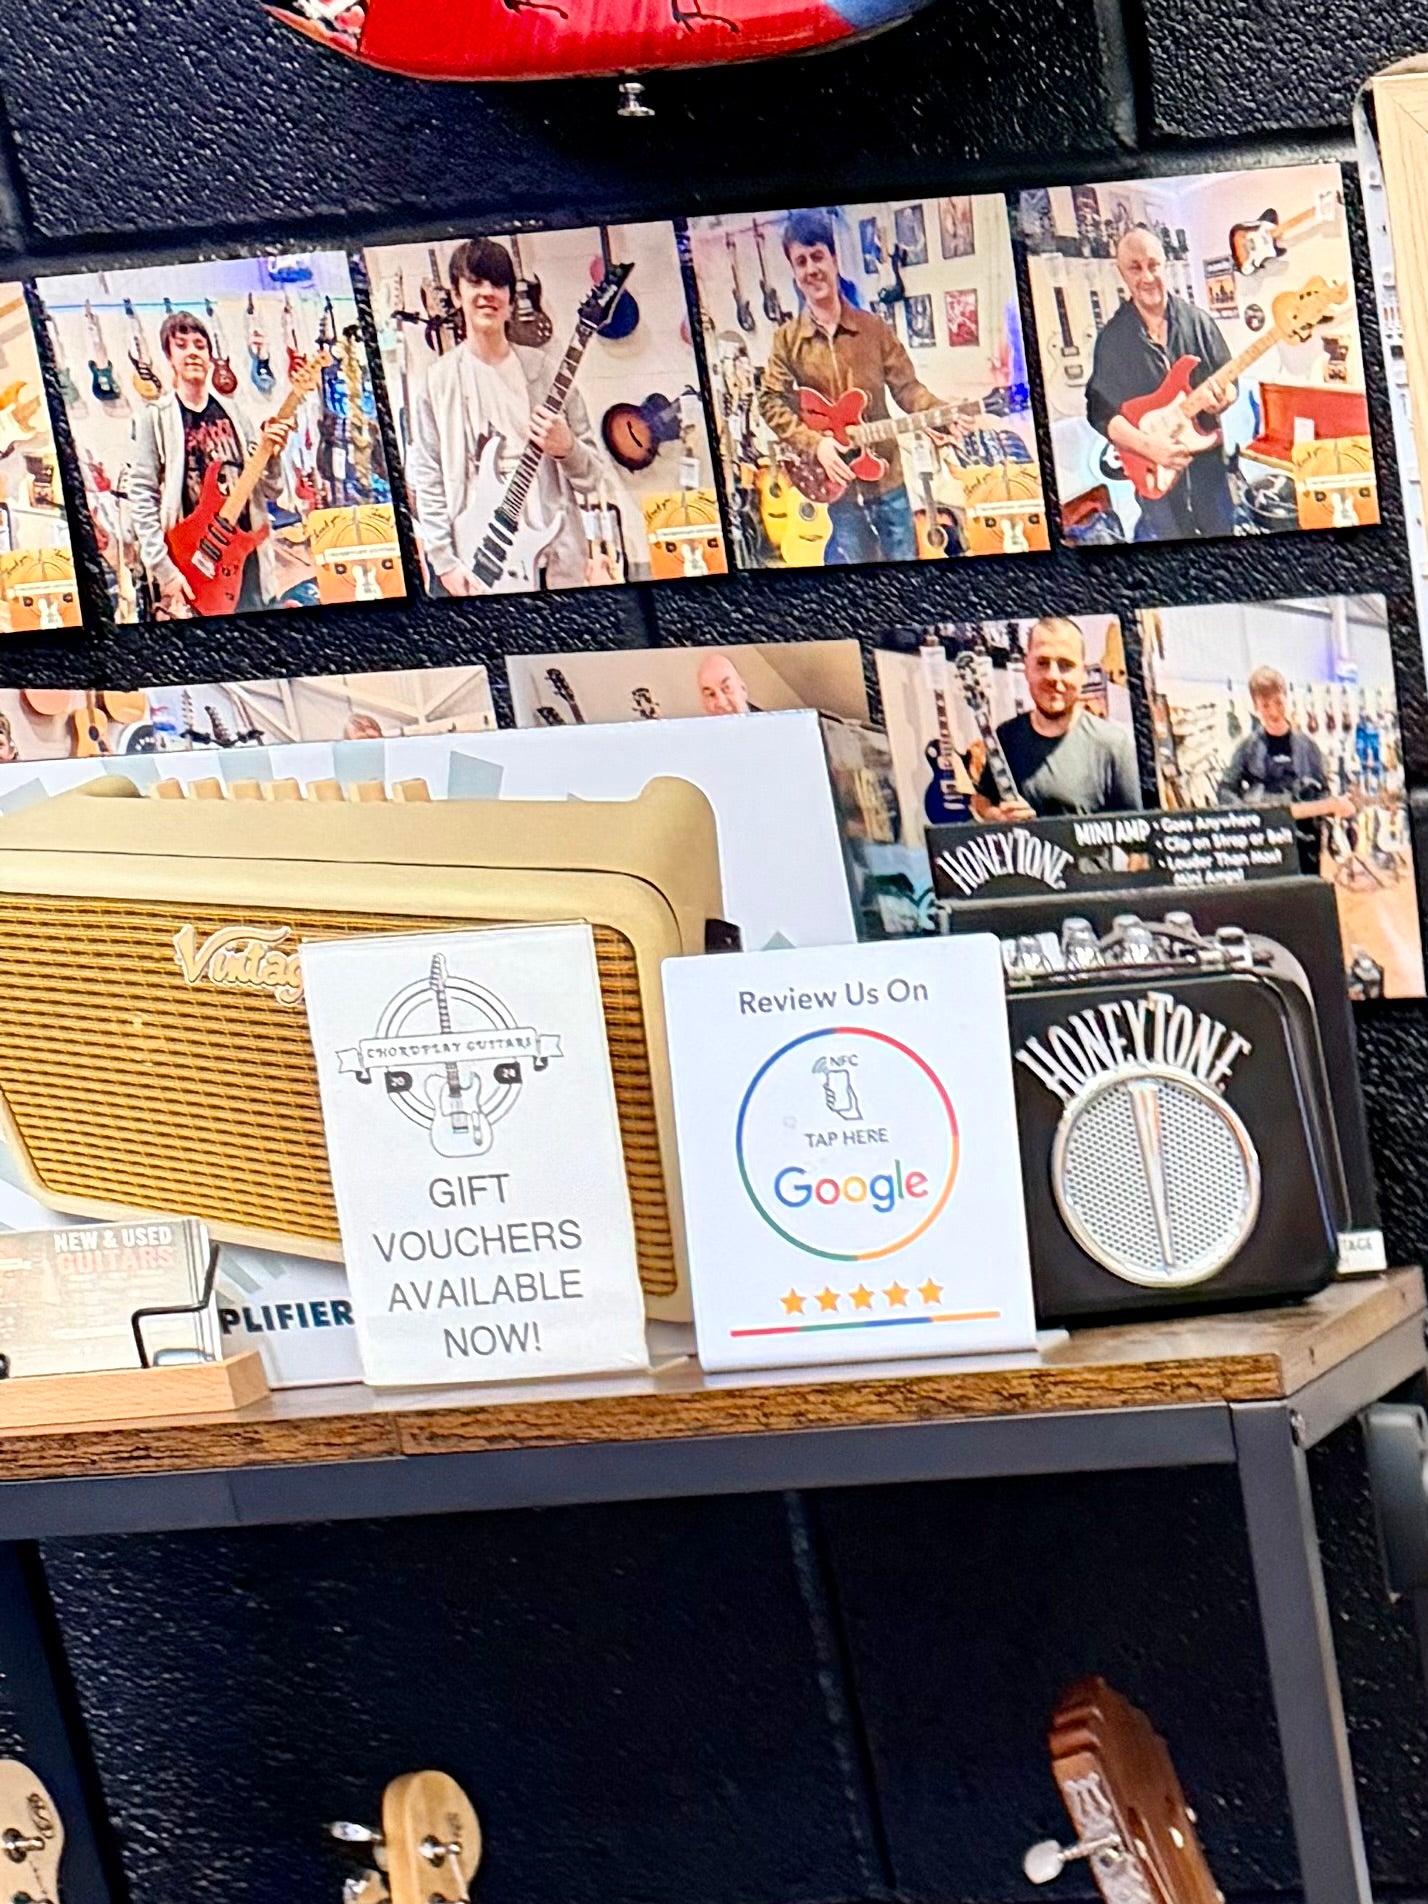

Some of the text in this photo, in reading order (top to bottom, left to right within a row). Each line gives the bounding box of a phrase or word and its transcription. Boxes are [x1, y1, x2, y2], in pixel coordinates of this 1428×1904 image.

[936, 827, 1075, 896] HONEYTONE
[173, 924, 305, 1006] Vintag
[739, 978, 929, 1014] Review Us On
[366, 1036, 532, 1059] CHORDPLAY GUITARS
[829, 1054, 859, 1067] NFC
[1014, 991, 1251, 1108] HONEYTONE
[804, 1127, 889, 1148] TAP HERE
[429, 1173, 510, 1208] GIFT
[774, 1159, 929, 1213] Google
[53, 1226, 173, 1252] NEW & USED
[372, 1219, 583, 1263] VOUCHERS
[56, 1245, 173, 1275] GUITARS
[388, 1269, 584, 1312] AVAILABLE
[218, 1300, 355, 1335] PLIFIER
[444, 1321, 542, 1358] NOW!
